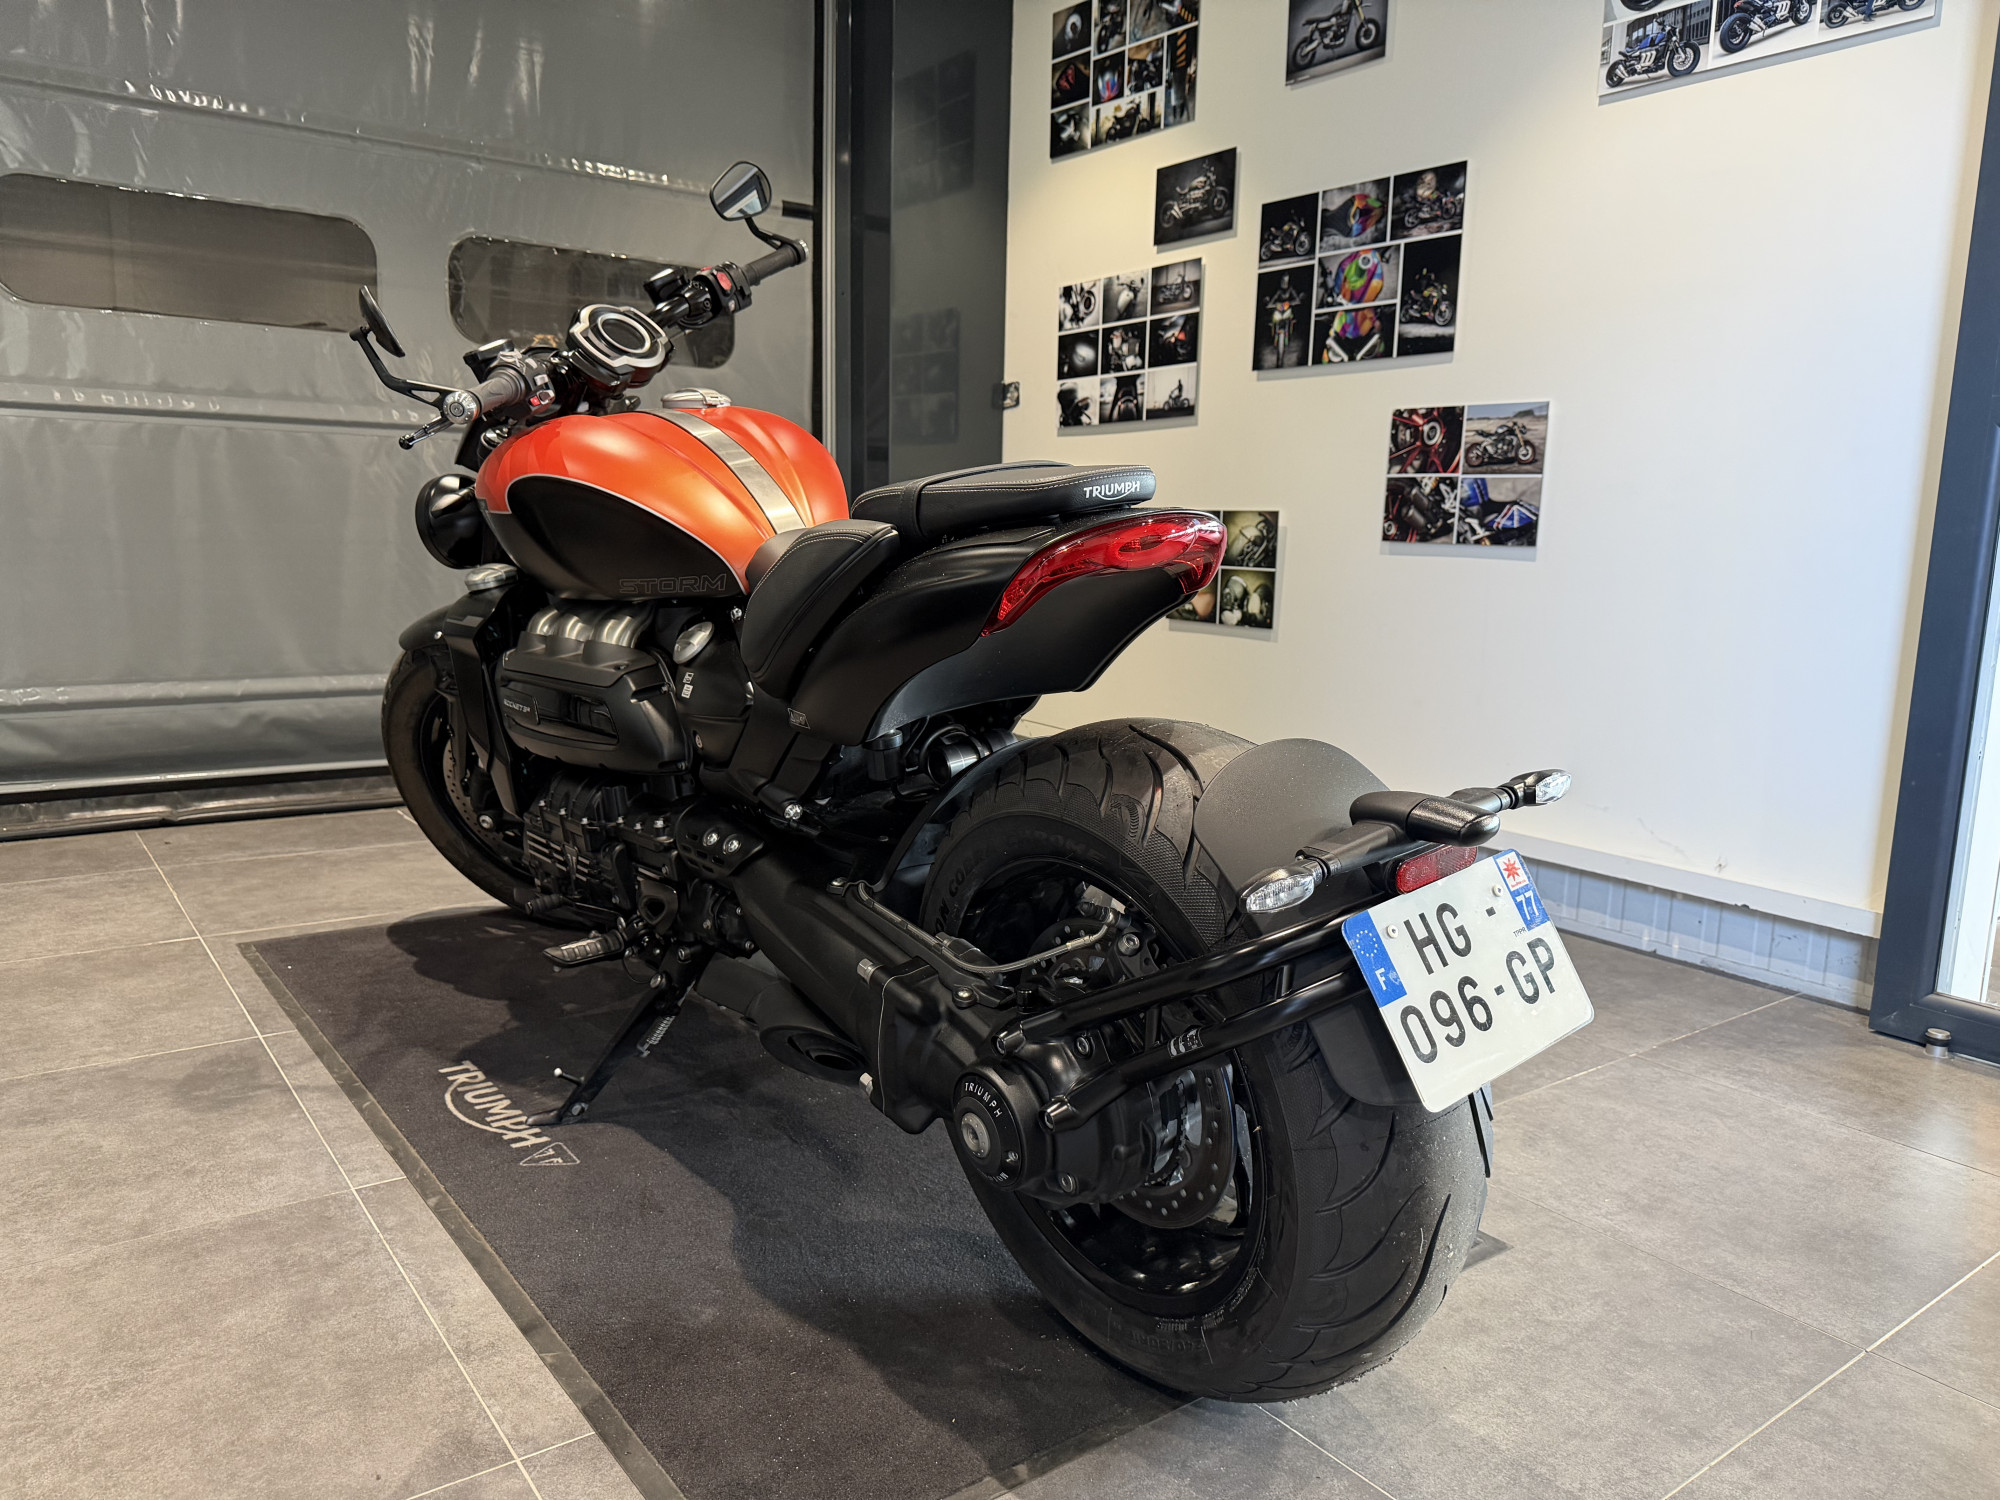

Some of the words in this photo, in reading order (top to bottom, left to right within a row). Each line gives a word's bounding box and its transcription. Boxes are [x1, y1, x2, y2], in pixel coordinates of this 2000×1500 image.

[1084, 481, 1140, 500] TRIUMPH
[619, 573, 727, 594] STORM
[1515, 890, 1539, 920] 77
[1374, 967, 1388, 991] F
[438, 1060, 551, 1148] TRIUMPH
[965, 1082, 1003, 1118] TRIUMPH
